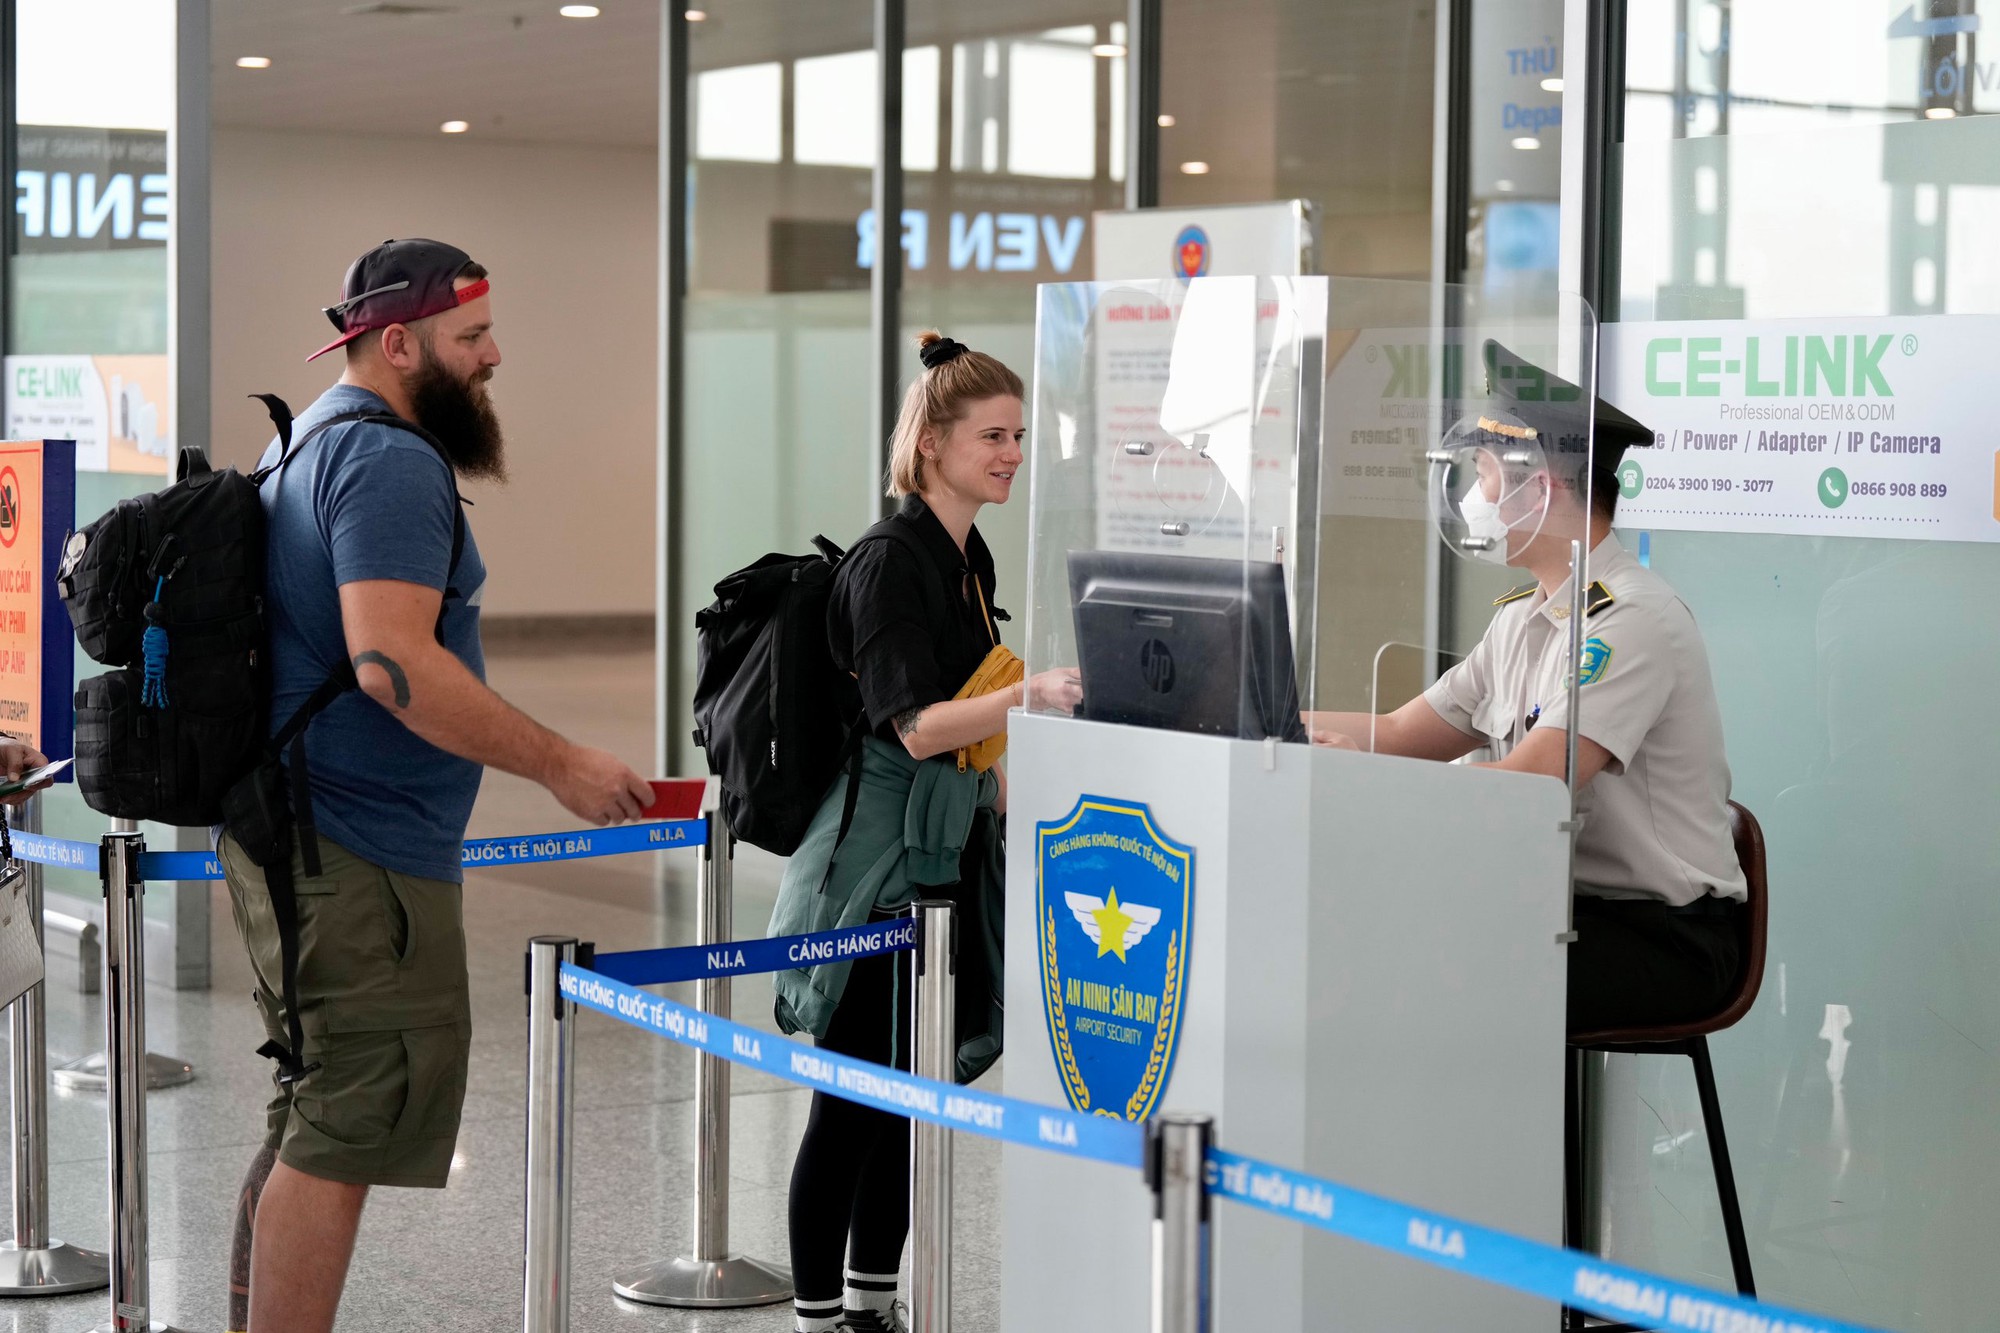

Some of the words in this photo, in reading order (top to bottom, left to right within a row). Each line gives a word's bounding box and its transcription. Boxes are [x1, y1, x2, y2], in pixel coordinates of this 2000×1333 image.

[1502, 103, 1563, 134] Depa
[1645, 334, 1895, 397] CE-LINK
[1720, 403, 1803, 421] Professional
[1808, 403, 1895, 421] OEM&ODM
[1683, 430, 1738, 451] Power
[1757, 430, 1827, 455] Adapter
[1848, 431, 1864, 453] IP
[1870, 431, 1941, 454] Camera
[1646, 476, 1676, 491] 0204
[1678, 477, 1709, 491] 3900
[1712, 478, 1733, 492] 190
[1743, 479, 1774, 493] 3077
[1851, 481, 1888, 496] 0866
[1890, 482, 1917, 497] 908
[1920, 483, 1948, 498] 889
[9, 610, 26, 634] PHIM
[28, 840, 47, 859] QUỐC
[48, 842, 57, 861] TẾ
[58, 845, 70, 866] NỘI
[461, 841, 506, 862] QUỐC
[509, 837, 529, 859] TẾ
[533, 840, 562, 862] NỘI
[566, 837, 592, 853] BÀI
[649, 826, 686, 843] N.I.A
[1049, 840, 1069, 859] CẢNG
[1069, 834, 1091, 850] HÀNG
[1092, 831, 1119, 848] KHÔNG
[1120, 837, 1142, 856] QUỐC
[1142, 844, 1153, 862] TẾ
[1151, 851, 1167, 873] NỘI
[1164, 862, 1181, 884] BÀI
[707, 949, 746, 970] N.I.A
[788, 937, 834, 962] CẢNG
[837, 931, 882, 957] HÀNG
[1066, 977, 1081, 1007] AN
[1083, 981, 1111, 1014] NINH
[1112, 984, 1134, 1019] SÂN
[1135, 993, 1158, 1024] BAY
[1075, 1016, 1106, 1037] AIRPORT
[1107, 1023, 1143, 1046] SECURITY
[579, 979, 615, 1010] KHÔNG
[617, 994, 648, 1022] QUỐC
[650, 1003, 664, 1027] TẾ
[665, 1010, 685, 1037] NỘI
[687, 1018, 708, 1044] BÀI
[732, 1033, 762, 1061] N.I.A
[837, 1064, 940, 1116] INTERNATIONAL
[943, 1095, 1005, 1130] AIRPORT
[1038, 1115, 1079, 1147] N.I.A
[1406, 1217, 1466, 1259] N.I.A
